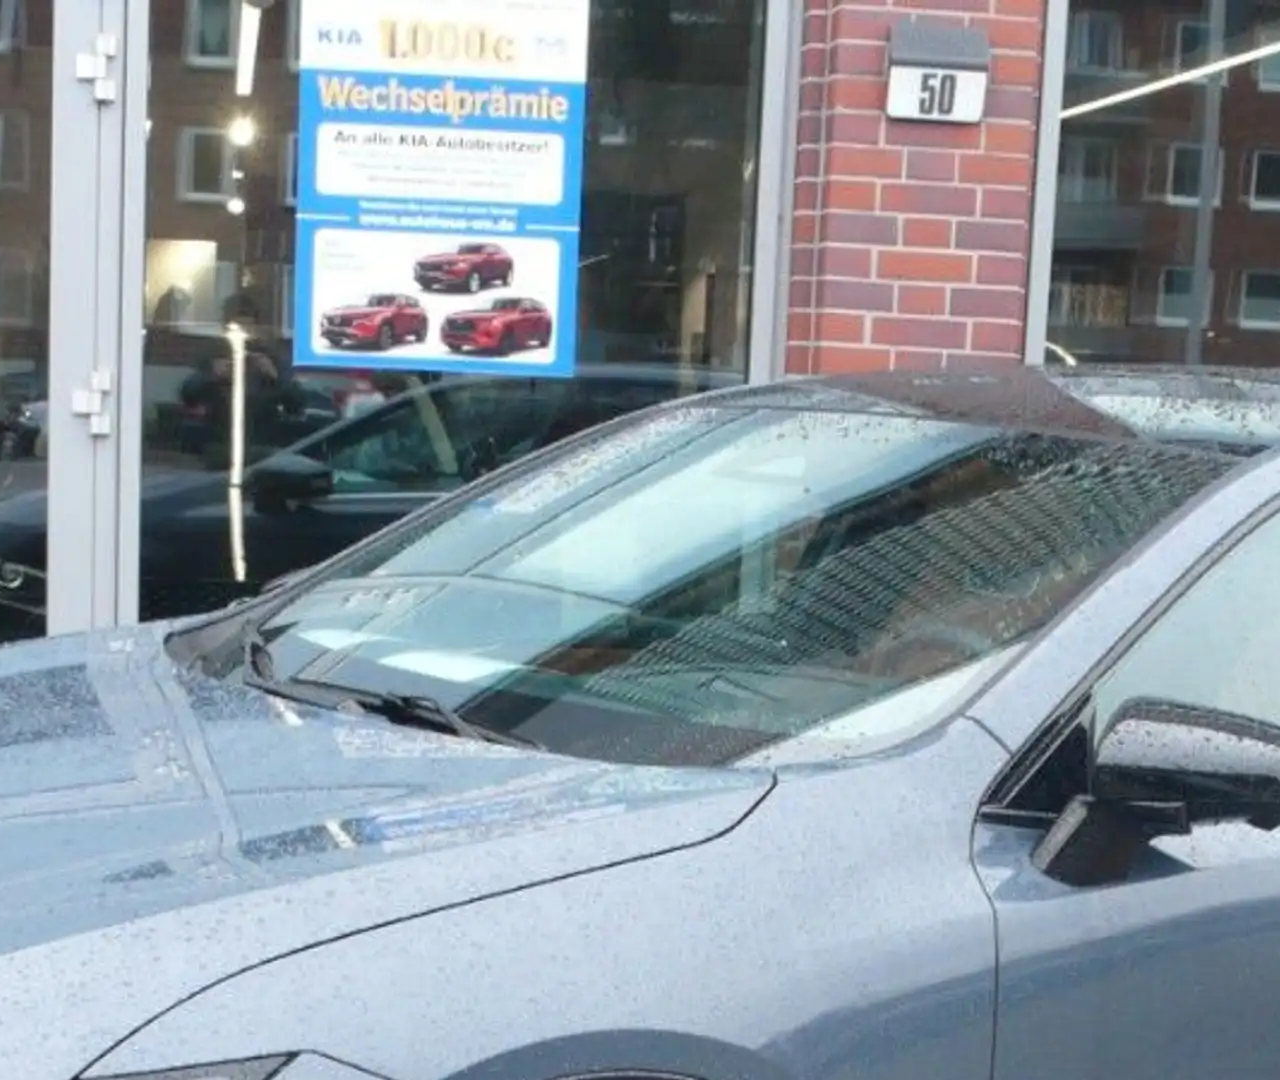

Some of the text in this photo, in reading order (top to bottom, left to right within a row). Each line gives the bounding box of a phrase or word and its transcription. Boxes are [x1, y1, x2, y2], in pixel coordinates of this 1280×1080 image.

[318, 28, 363, 46] KIA
[317, 75, 570, 124] Wechselprämie
[919, 73, 957, 115] 50
[333, 130, 357, 145] An
